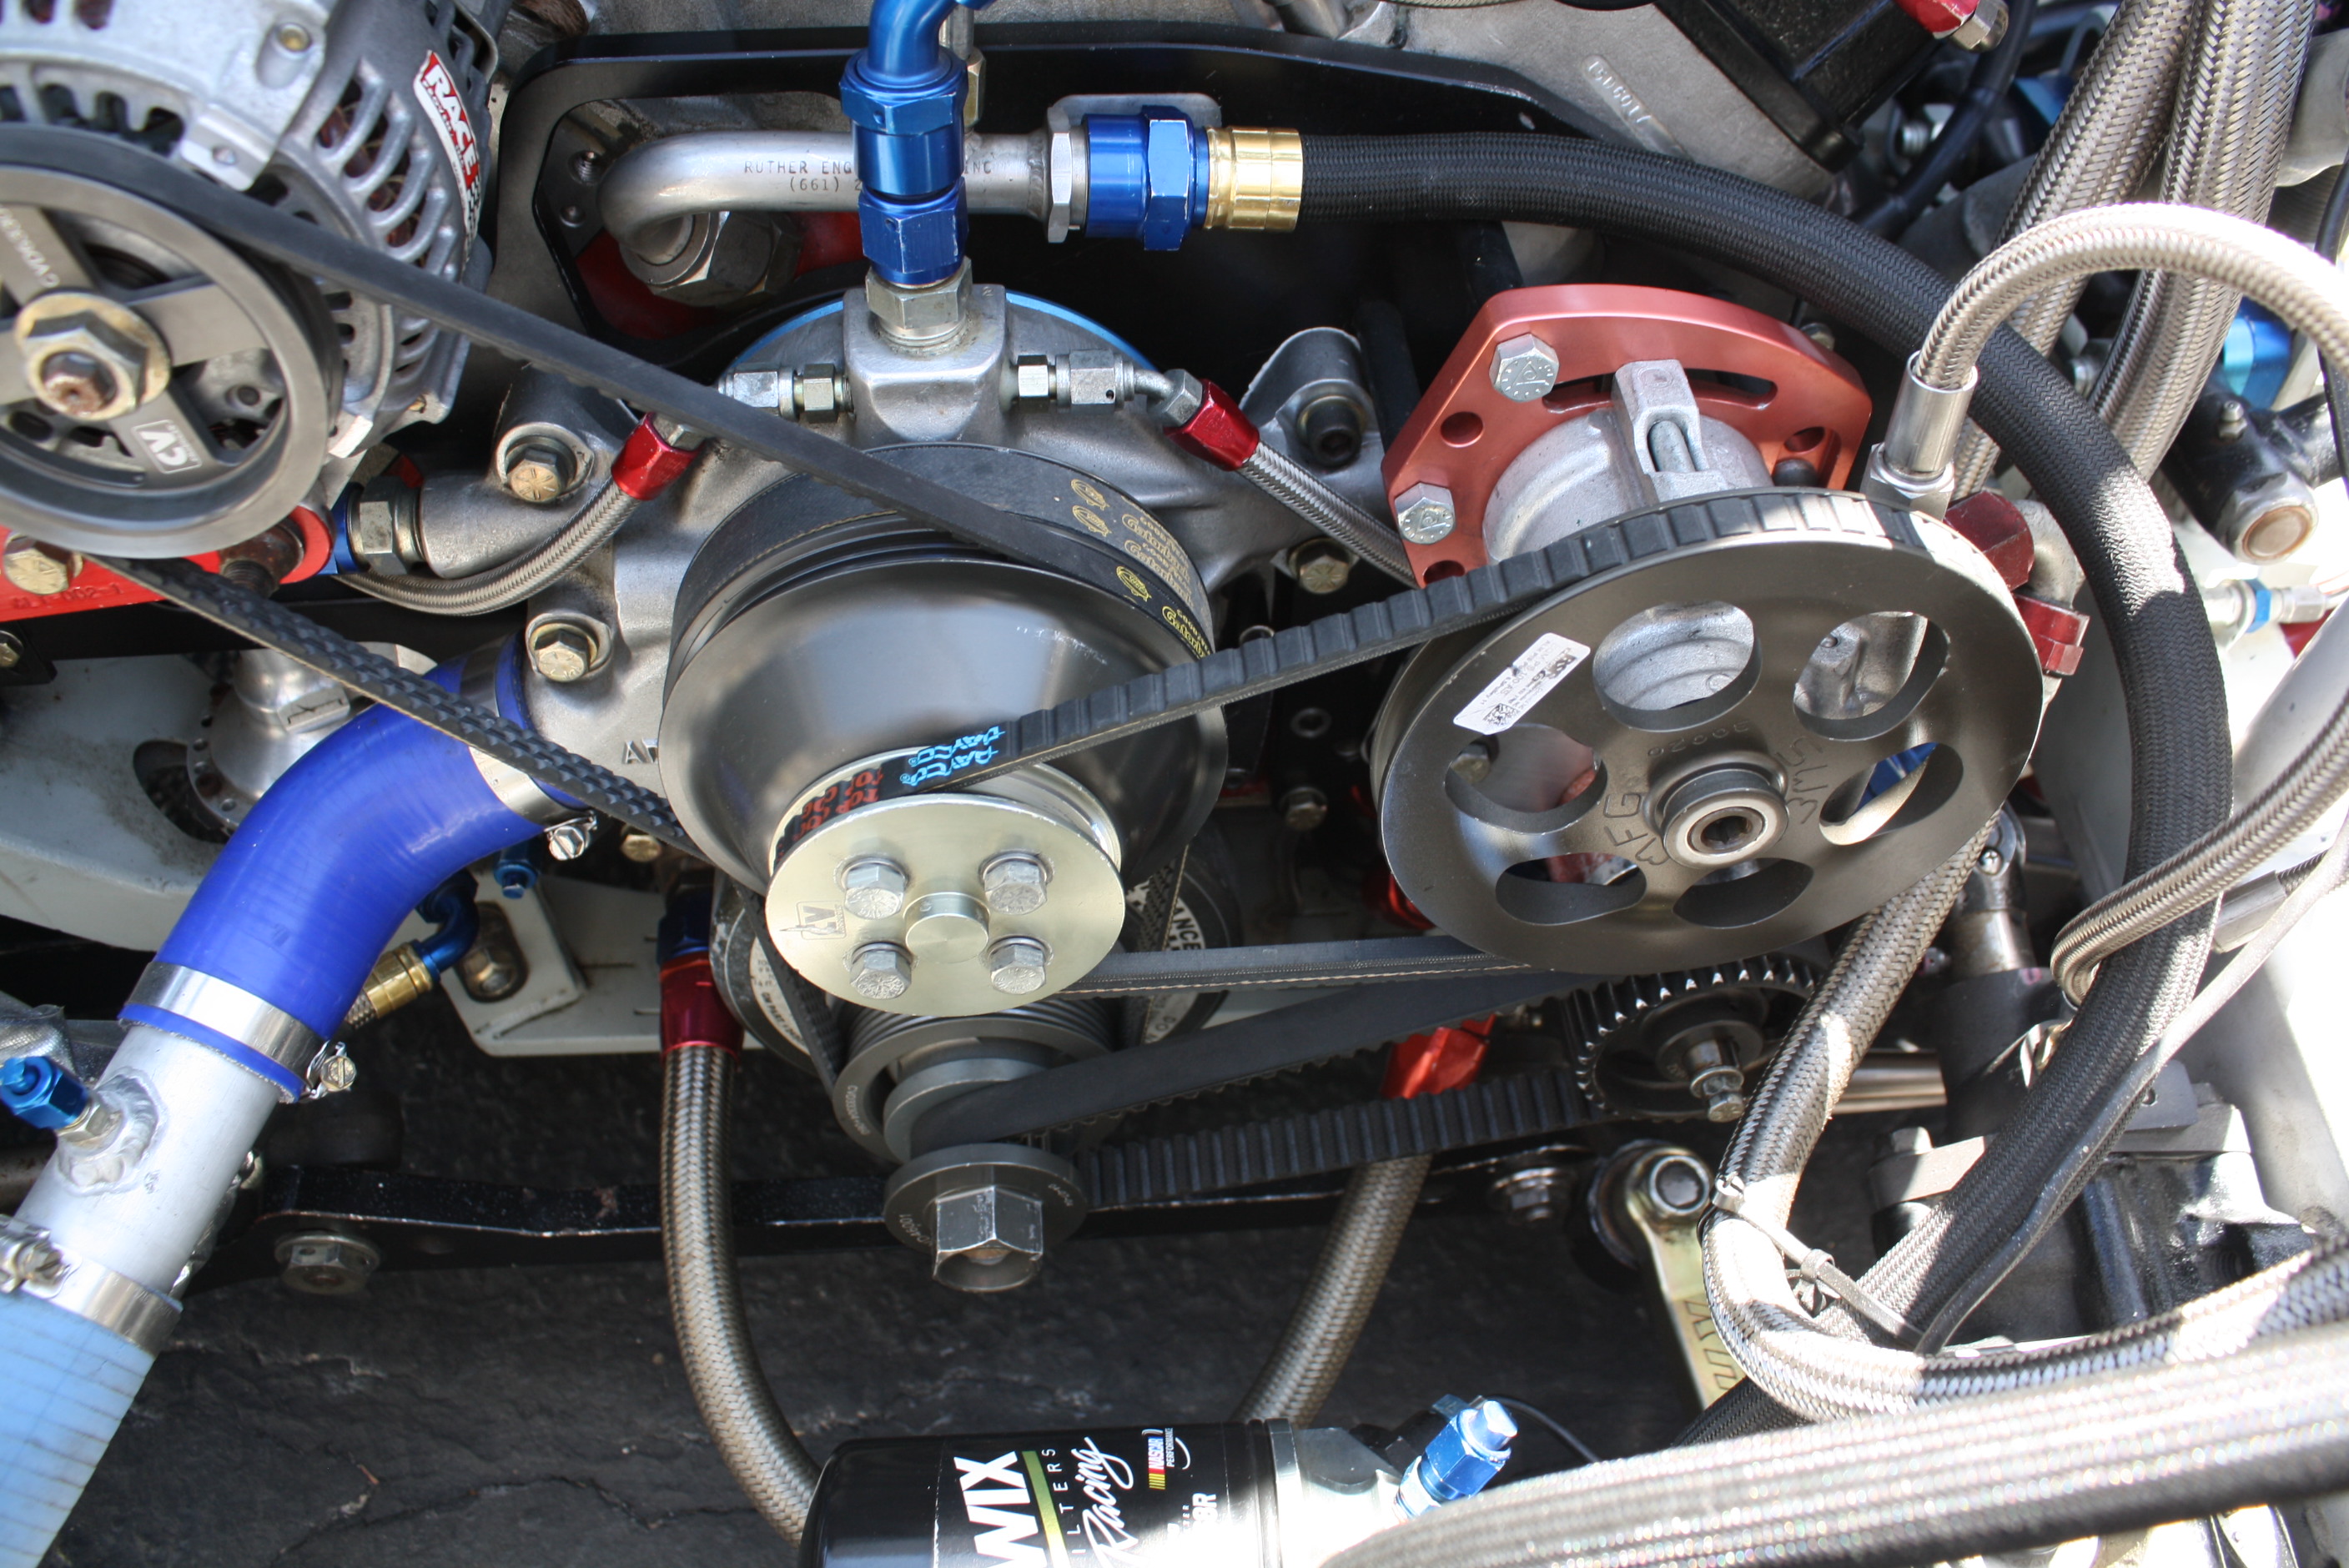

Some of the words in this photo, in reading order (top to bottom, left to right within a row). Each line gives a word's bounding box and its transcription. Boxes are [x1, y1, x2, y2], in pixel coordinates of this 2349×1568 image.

[425, 64, 479, 176] RACE
[744, 160, 808, 174] RUTHER
[790, 178, 839, 192] (661)
[138, 430, 188, 466] CV
[918, 726, 1005, 765] DAYCO
[909, 746, 998, 787] DAYCO
[1148, 1435, 1164, 1470] NASCAR
[1164, 1427, 1175, 1468] PERFORMANCE
[953, 1450, 1048, 1568] WIX
[1042, 1449, 1086, 1554] ILTERS
[1071, 1436, 1143, 1568] Racing
